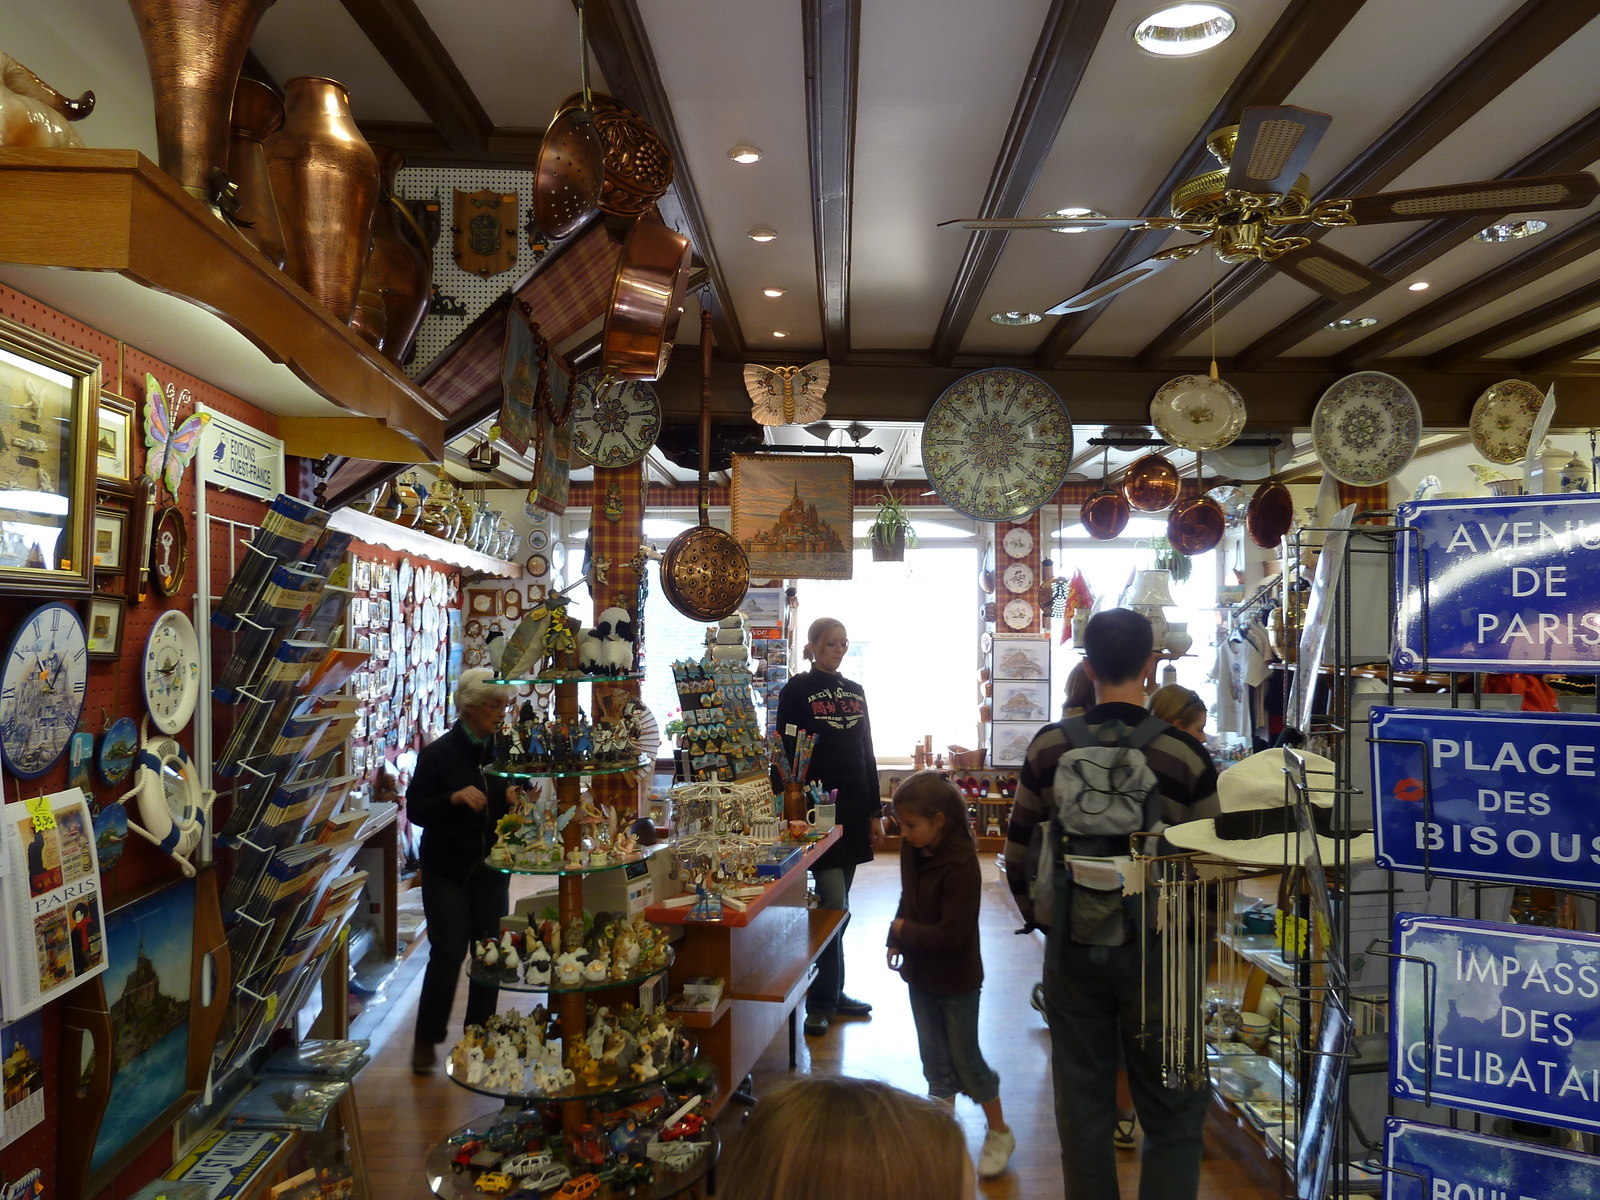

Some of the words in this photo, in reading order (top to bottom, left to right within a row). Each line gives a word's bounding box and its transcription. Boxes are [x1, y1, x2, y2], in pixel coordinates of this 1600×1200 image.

[1512, 566, 1567, 597] DE
[1477, 612, 1600, 645] PARIS
[1432, 738, 1596, 777] PLACE
[1477, 788, 1551, 816] DES
[34, 878, 96, 914] PARIS
[1501, 1005, 1575, 1047] DES
